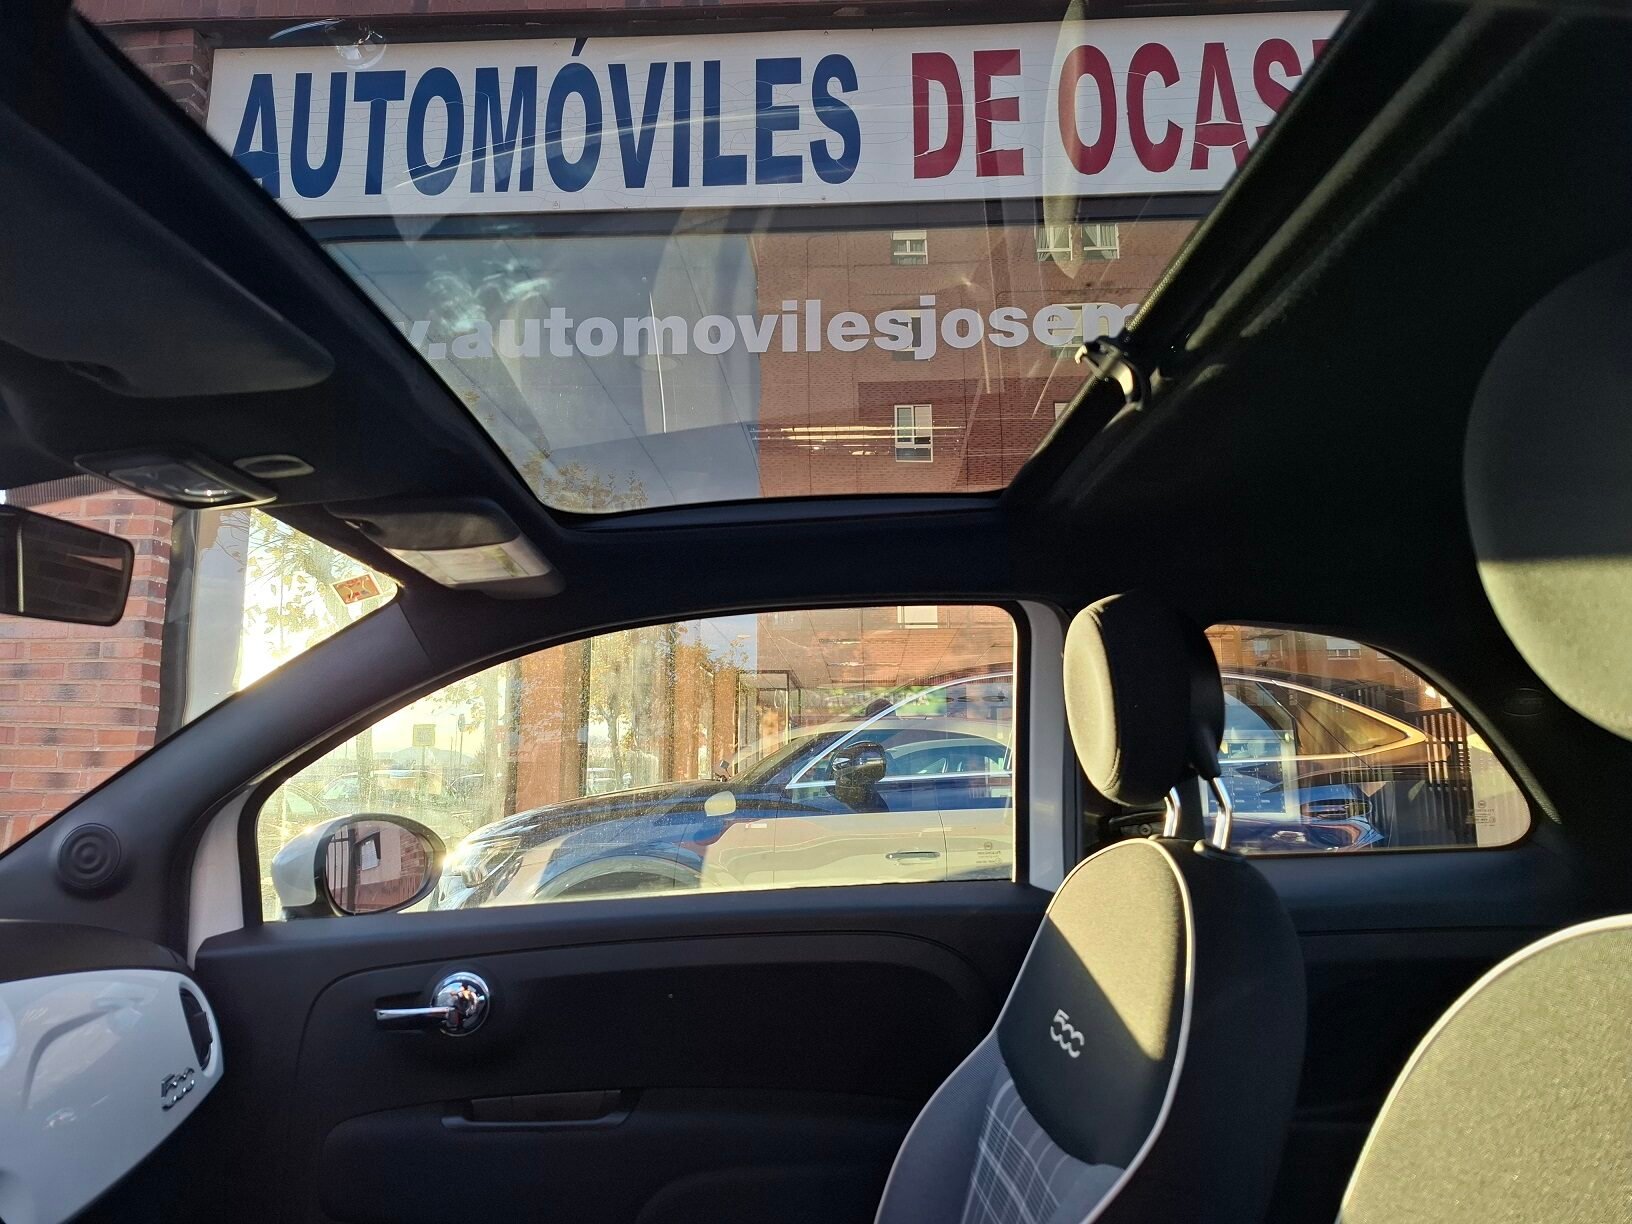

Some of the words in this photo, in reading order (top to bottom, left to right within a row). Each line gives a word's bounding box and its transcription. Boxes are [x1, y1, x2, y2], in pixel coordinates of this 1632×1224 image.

[231, 37, 862, 199] AUTOMÓVILES
[911, 49, 1025, 179] DE
[1058, 38, 1331, 176] OCAS
